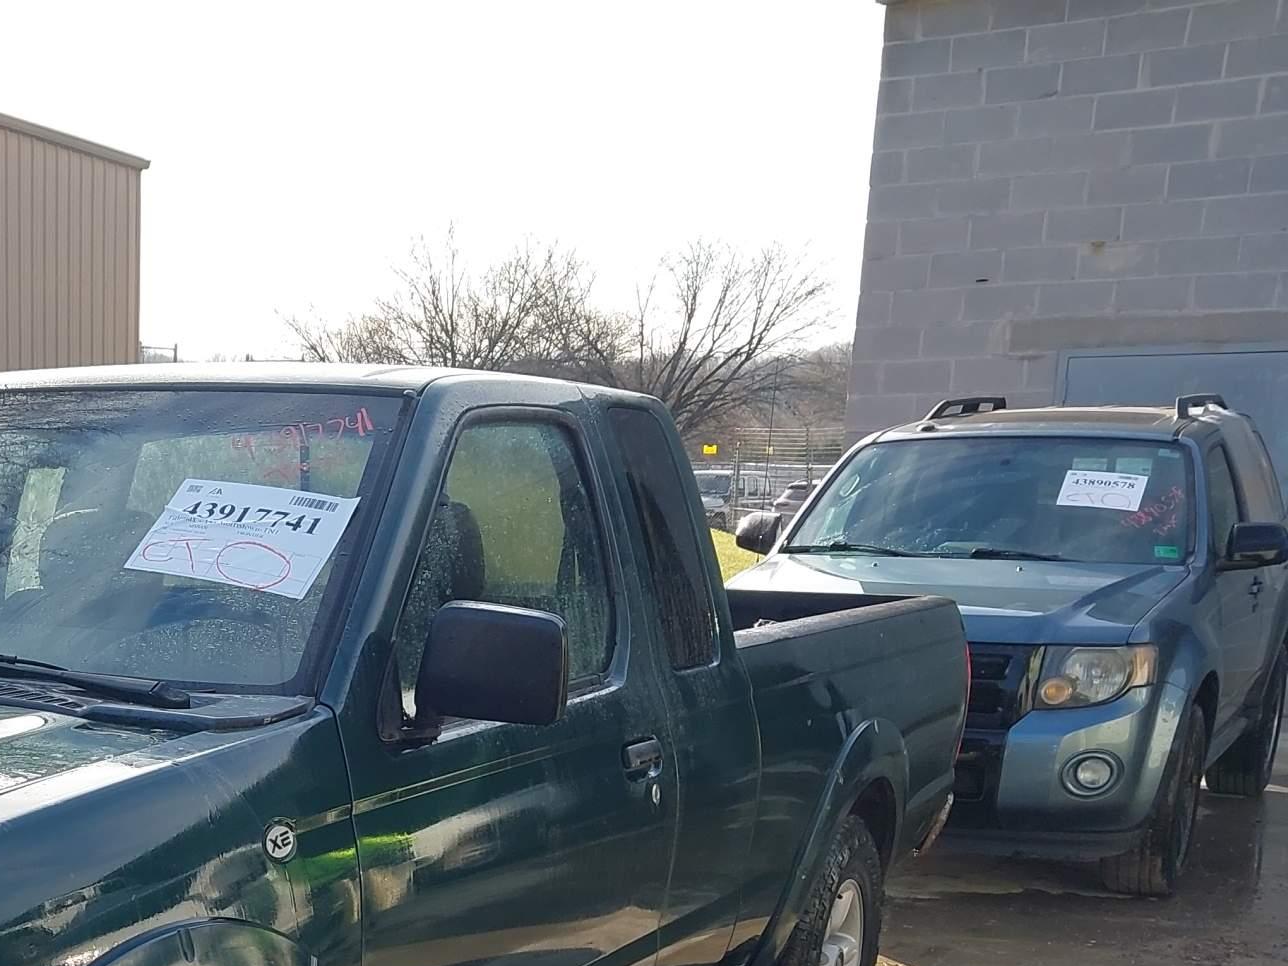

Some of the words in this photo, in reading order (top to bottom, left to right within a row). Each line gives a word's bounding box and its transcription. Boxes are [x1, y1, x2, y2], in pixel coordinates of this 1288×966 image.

[1072, 478, 1136, 489] 43890578
[184, 500, 324, 536] 43917741
[268, 830, 292, 854] XE
